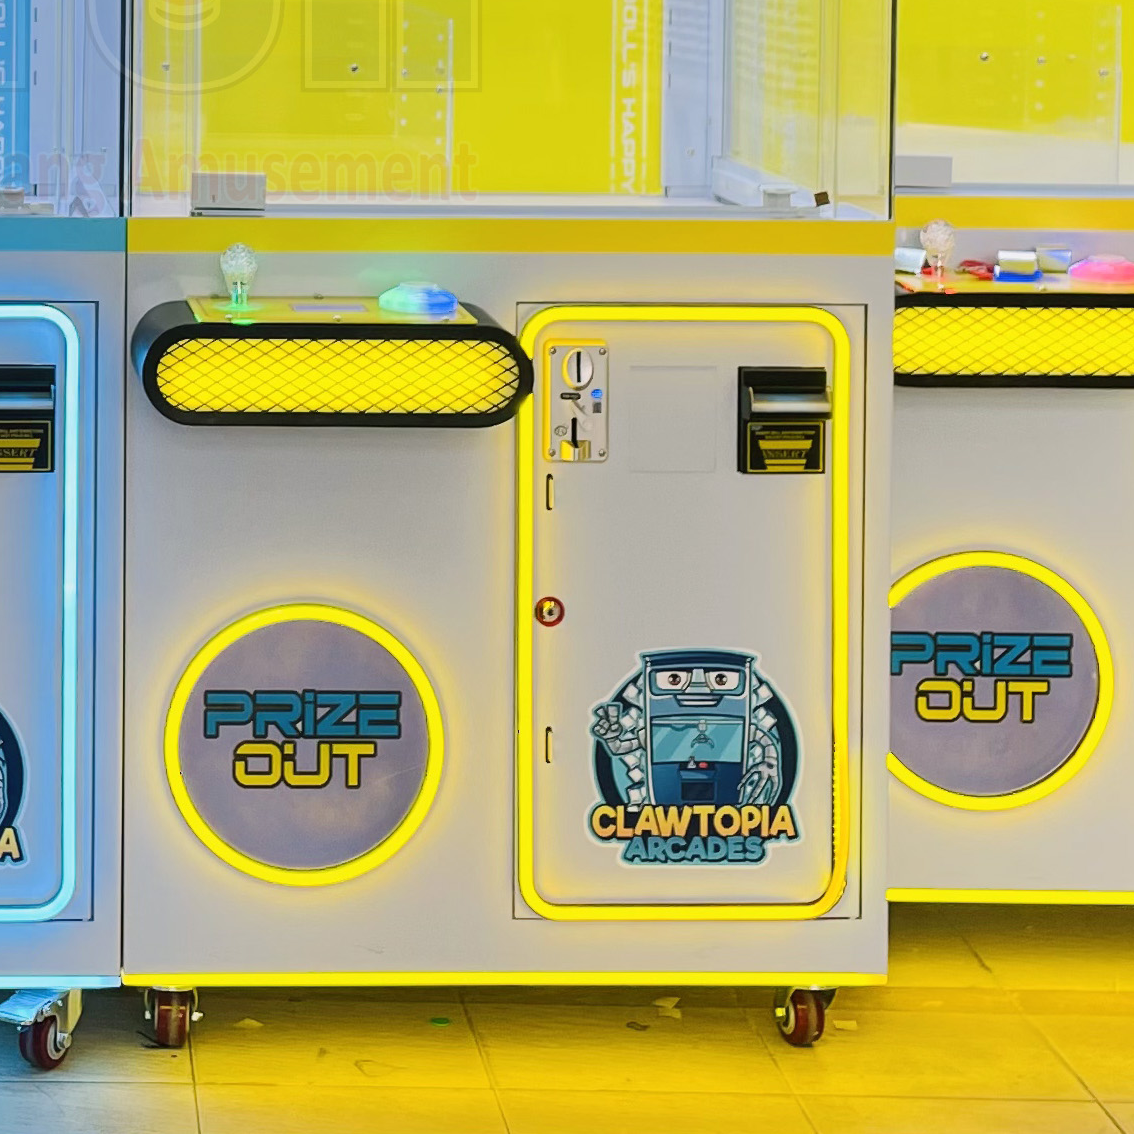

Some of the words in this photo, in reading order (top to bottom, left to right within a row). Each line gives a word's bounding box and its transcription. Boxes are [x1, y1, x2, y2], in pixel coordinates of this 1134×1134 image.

[621, 98, 636, 193] HAPPY
[915, 677, 1050, 723] OUT
[233, 740, 377, 789] OUT
[591, 804, 798, 840] CLAWTOPIA
[623, 835, 765, 862] ARCADES
